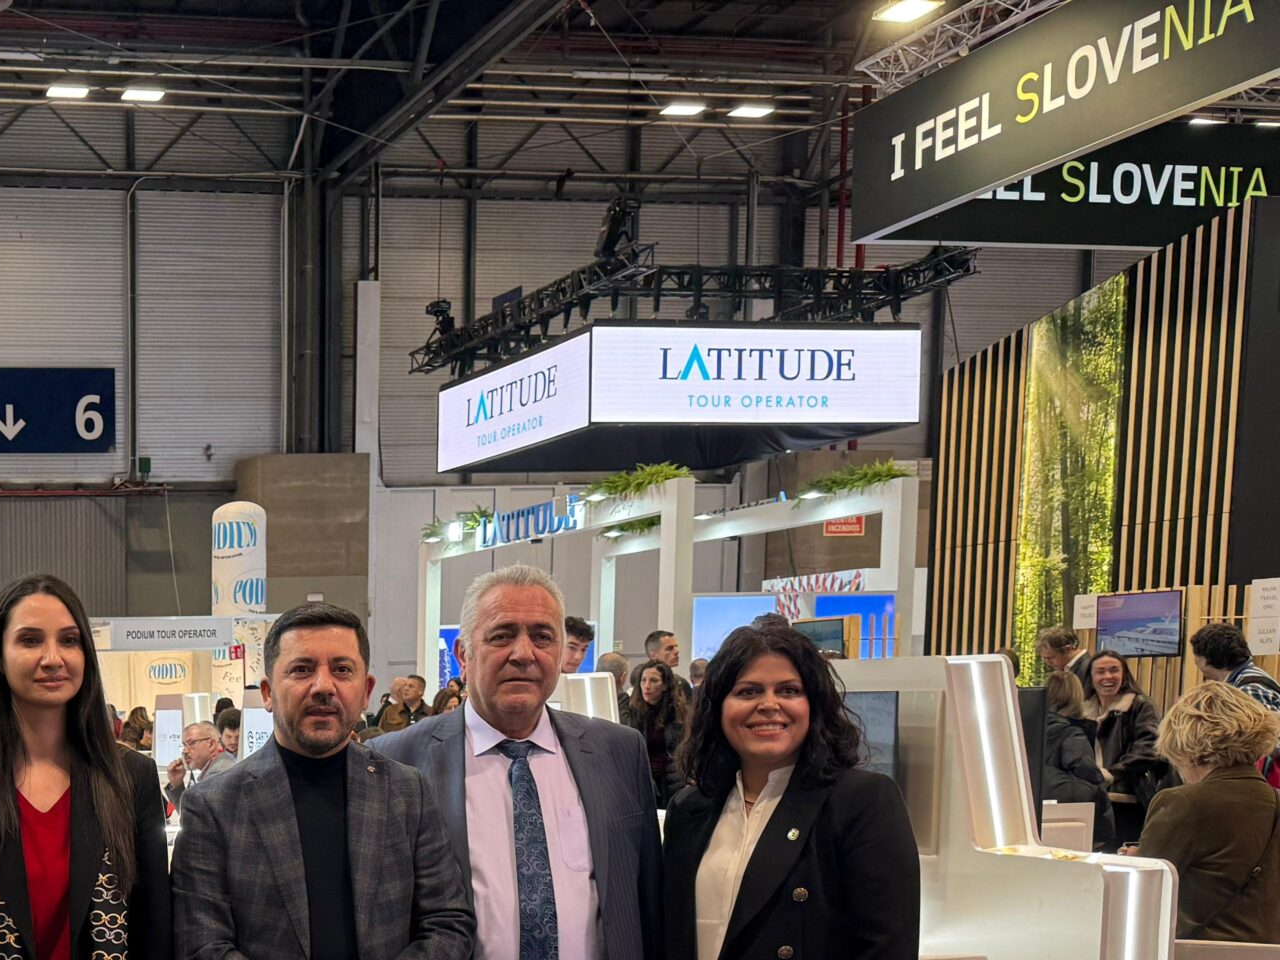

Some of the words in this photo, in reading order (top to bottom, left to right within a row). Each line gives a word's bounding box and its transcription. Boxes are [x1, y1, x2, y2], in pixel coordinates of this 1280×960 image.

[890, 132, 906, 182] I
[914, 92, 1002, 171] FEEL
[1015, 0, 1255, 124] SLOVENIA
[1060, 160, 1269, 207] SLOVENIA
[658, 343, 856, 381] LATITUDE
[465, 364, 558, 428] LATITUDE
[687, 394, 732, 409] TOUR
[741, 394, 829, 409] OPERATOR
[74, 394, 105, 441] 6
[476, 427, 499, 448] TOUR
[500, 415, 544, 441] OPERATOR
[126, 630, 155, 640] PODIUM
[156, 630, 177, 639] TOUR
[179, 629, 217, 639] OPERATOR
